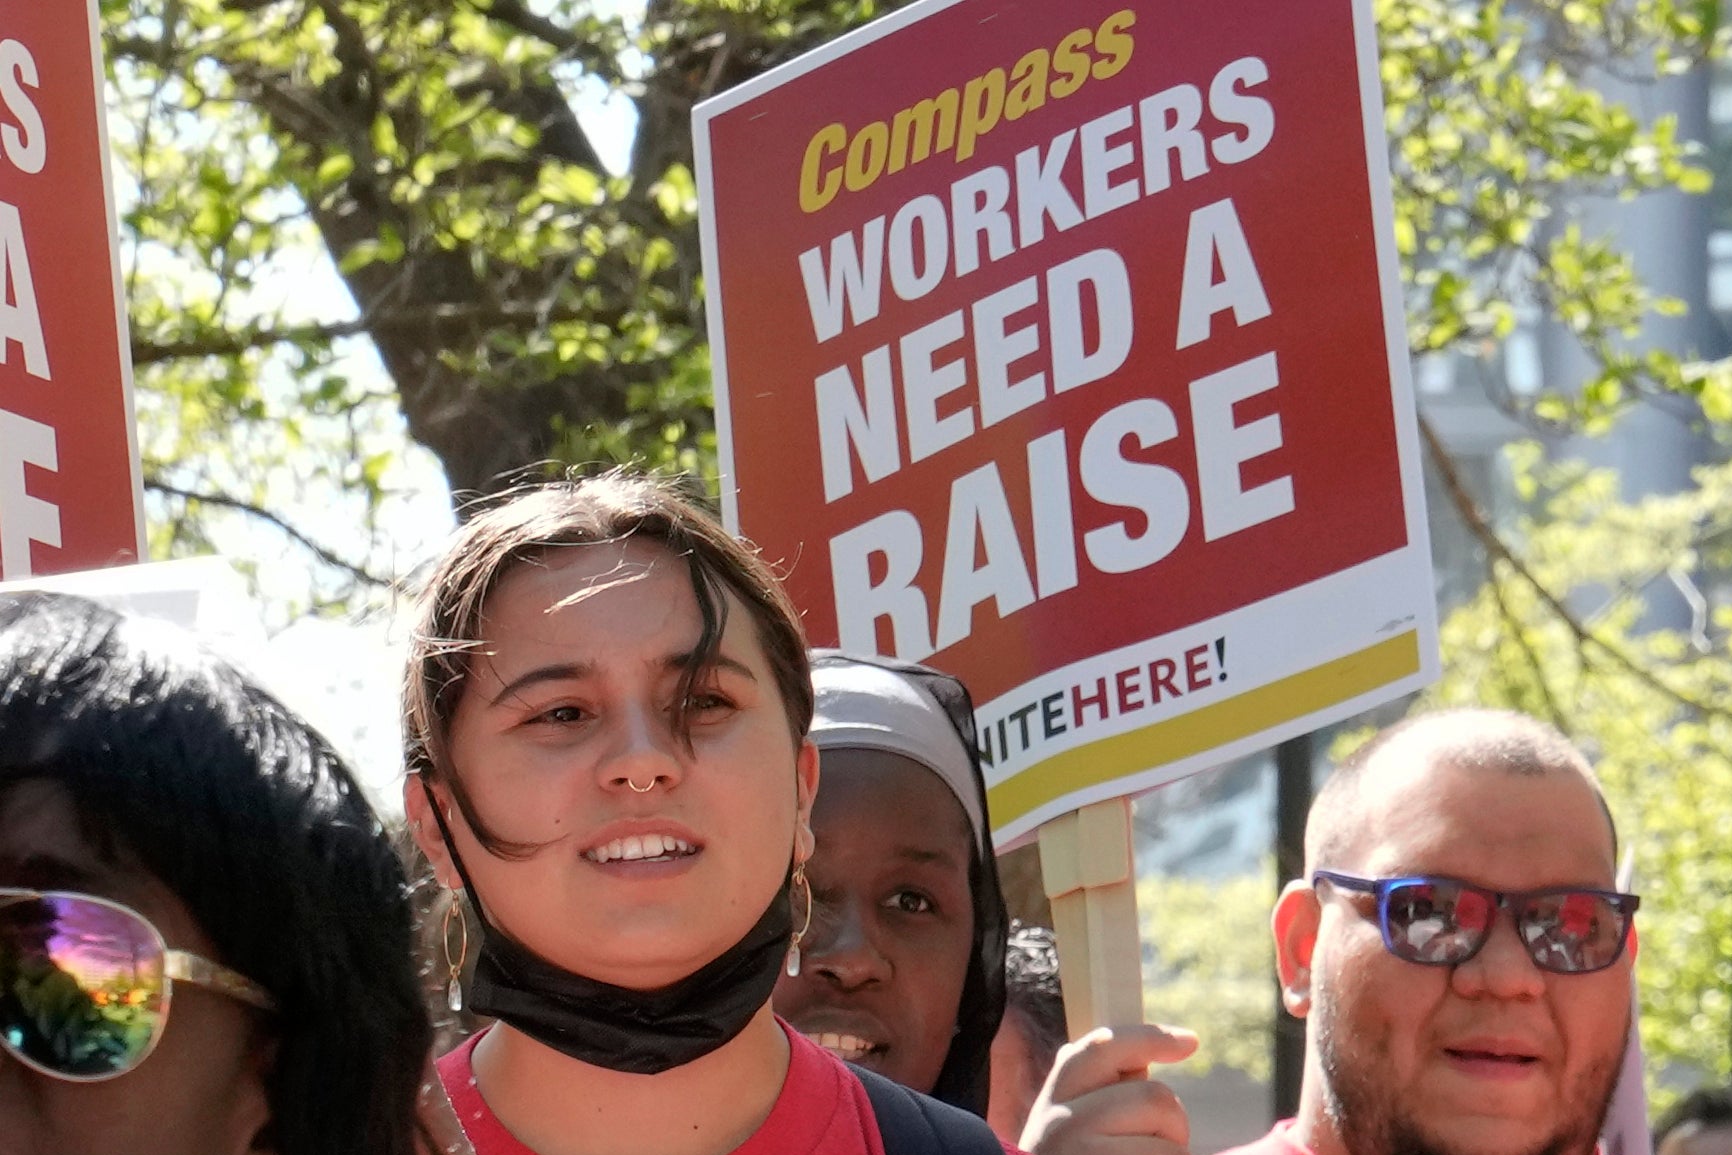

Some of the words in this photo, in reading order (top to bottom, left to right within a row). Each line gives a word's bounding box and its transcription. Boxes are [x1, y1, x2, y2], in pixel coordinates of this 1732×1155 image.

[798, 56, 1275, 343] WORKERS
[801, 8, 1137, 214] Compass
[814, 249, 1134, 505] NEED
[1176, 198, 1272, 350] A
[829, 352, 1295, 664] RAISE
